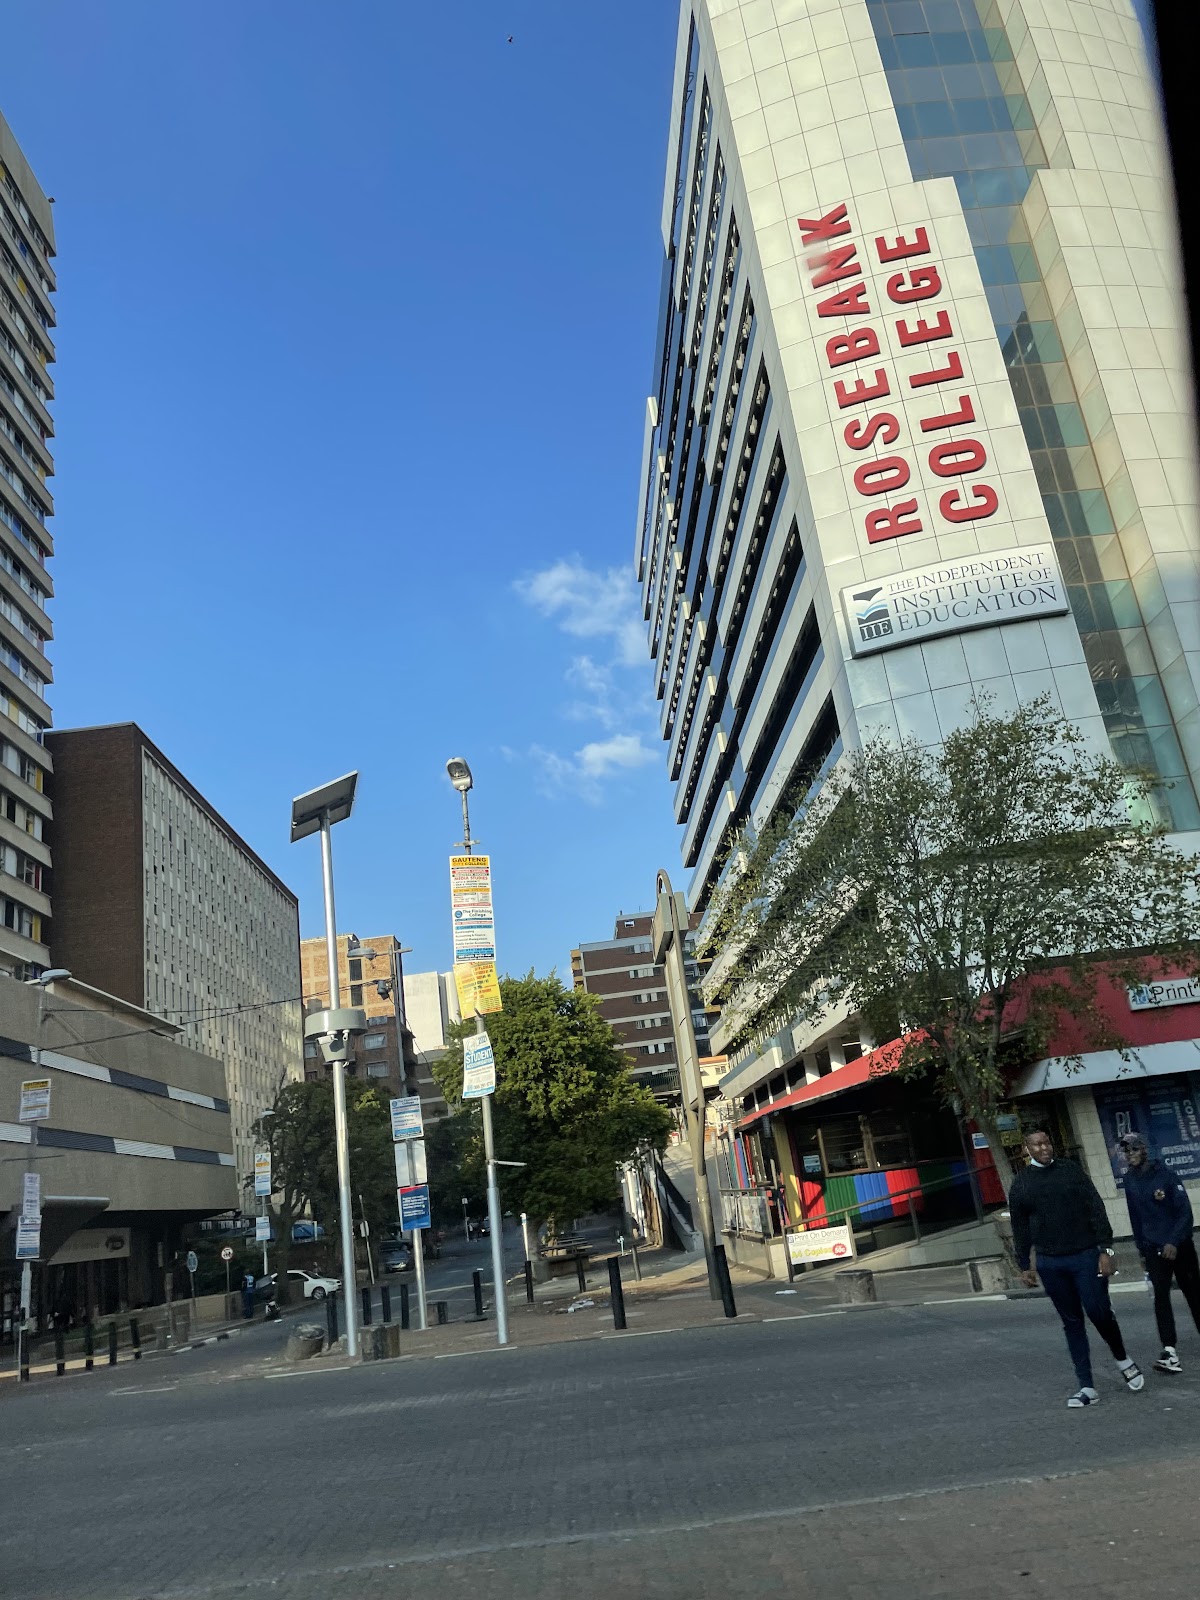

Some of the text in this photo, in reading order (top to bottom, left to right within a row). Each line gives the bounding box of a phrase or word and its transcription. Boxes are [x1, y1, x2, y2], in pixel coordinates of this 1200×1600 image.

[797, 203, 923, 544] ROSEBANK
[875, 226, 999, 524] COLLEGE
[886, 552, 1046, 593] THE INDEPENDENT
[893, 567, 1053, 614] INSTITUTE OF
[899, 585, 1058, 632] EDUCATION
[861, 621, 892, 640] IIE
[1151, 982, 1195, 1002] Print
[1182, 1099, 1200, 1137] COPIES
[1165, 1155, 1194, 1166] CARDS
[809, 1231, 820, 1239] On
[822, 1228, 848, 1238] Demand
